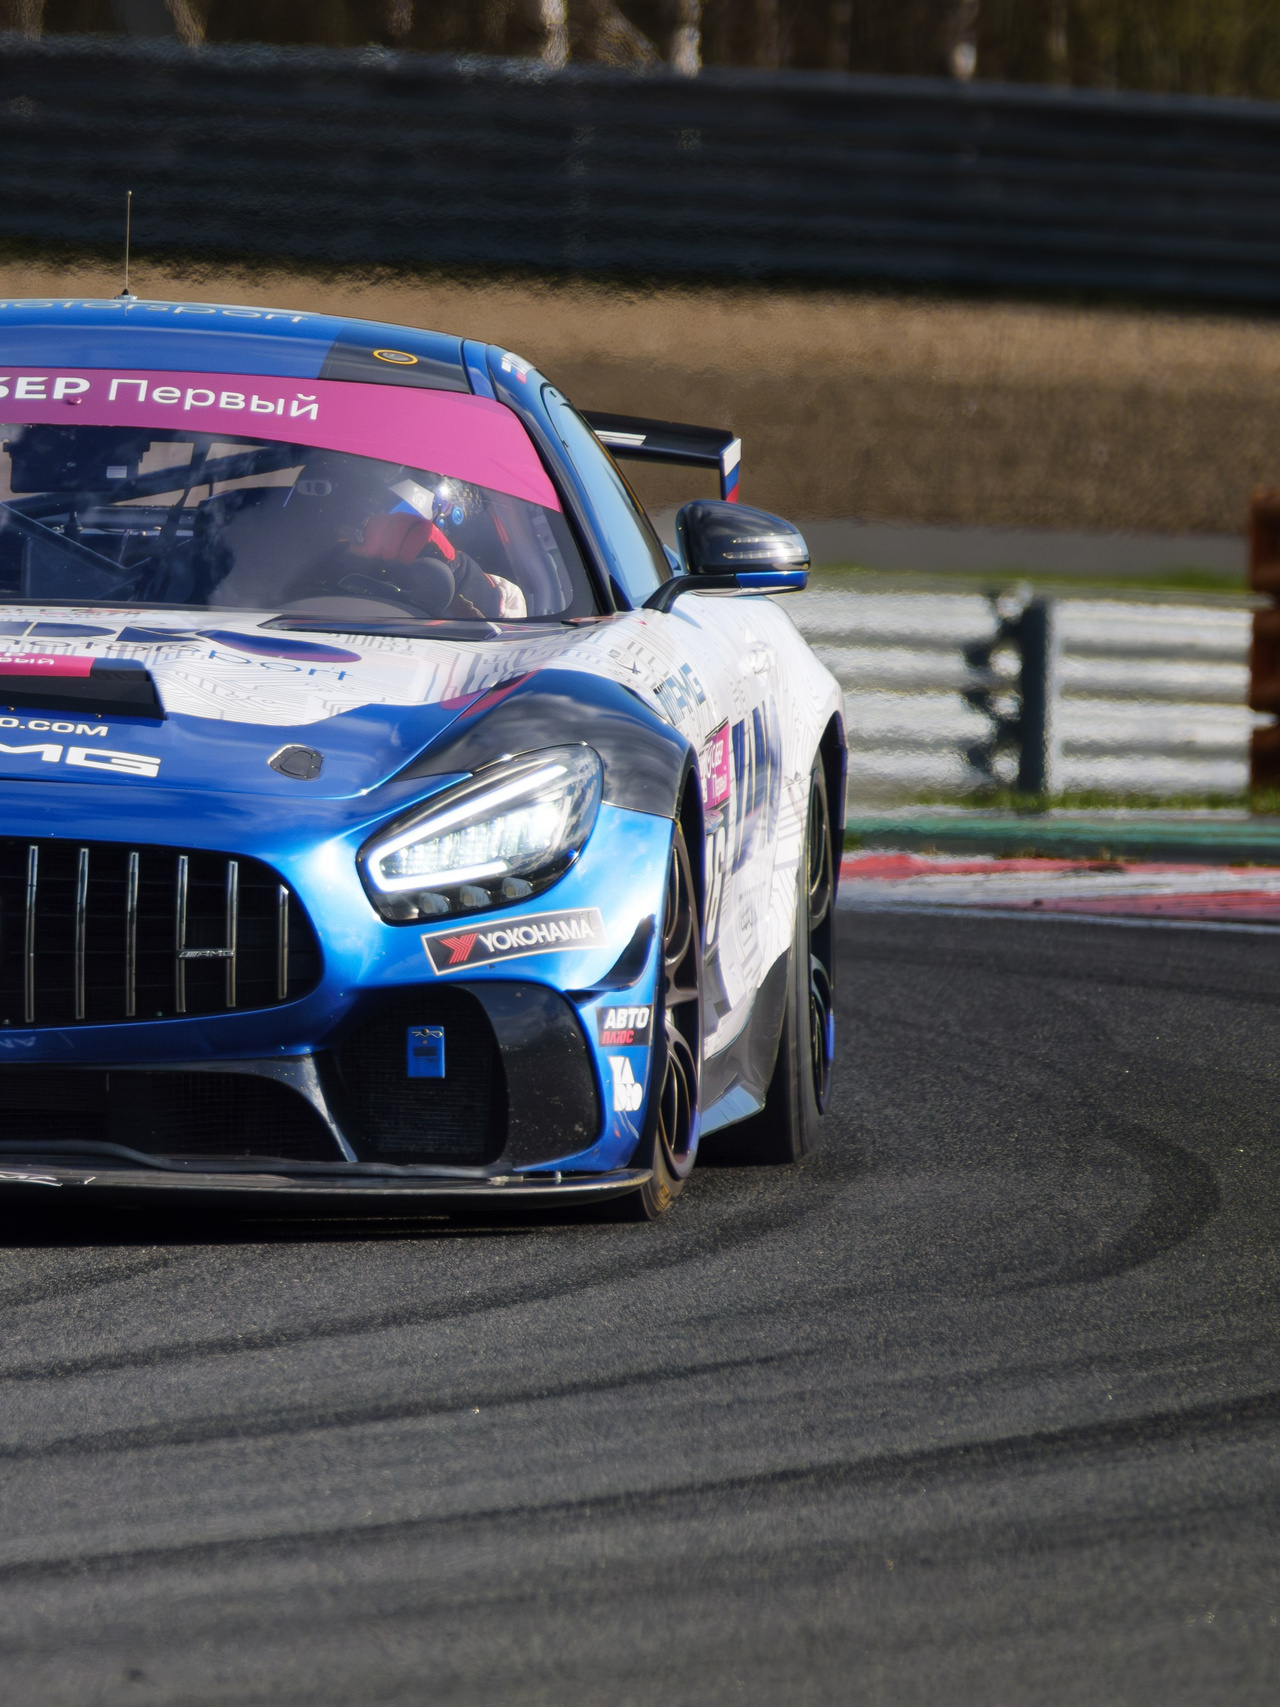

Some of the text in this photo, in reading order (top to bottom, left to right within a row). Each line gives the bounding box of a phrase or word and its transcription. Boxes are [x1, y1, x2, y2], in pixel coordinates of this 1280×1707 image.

[108, 378, 319, 420] Первый
[479, 919, 595, 952] YOKOHAMA
[604, 1007, 650, 1030] АВТО
